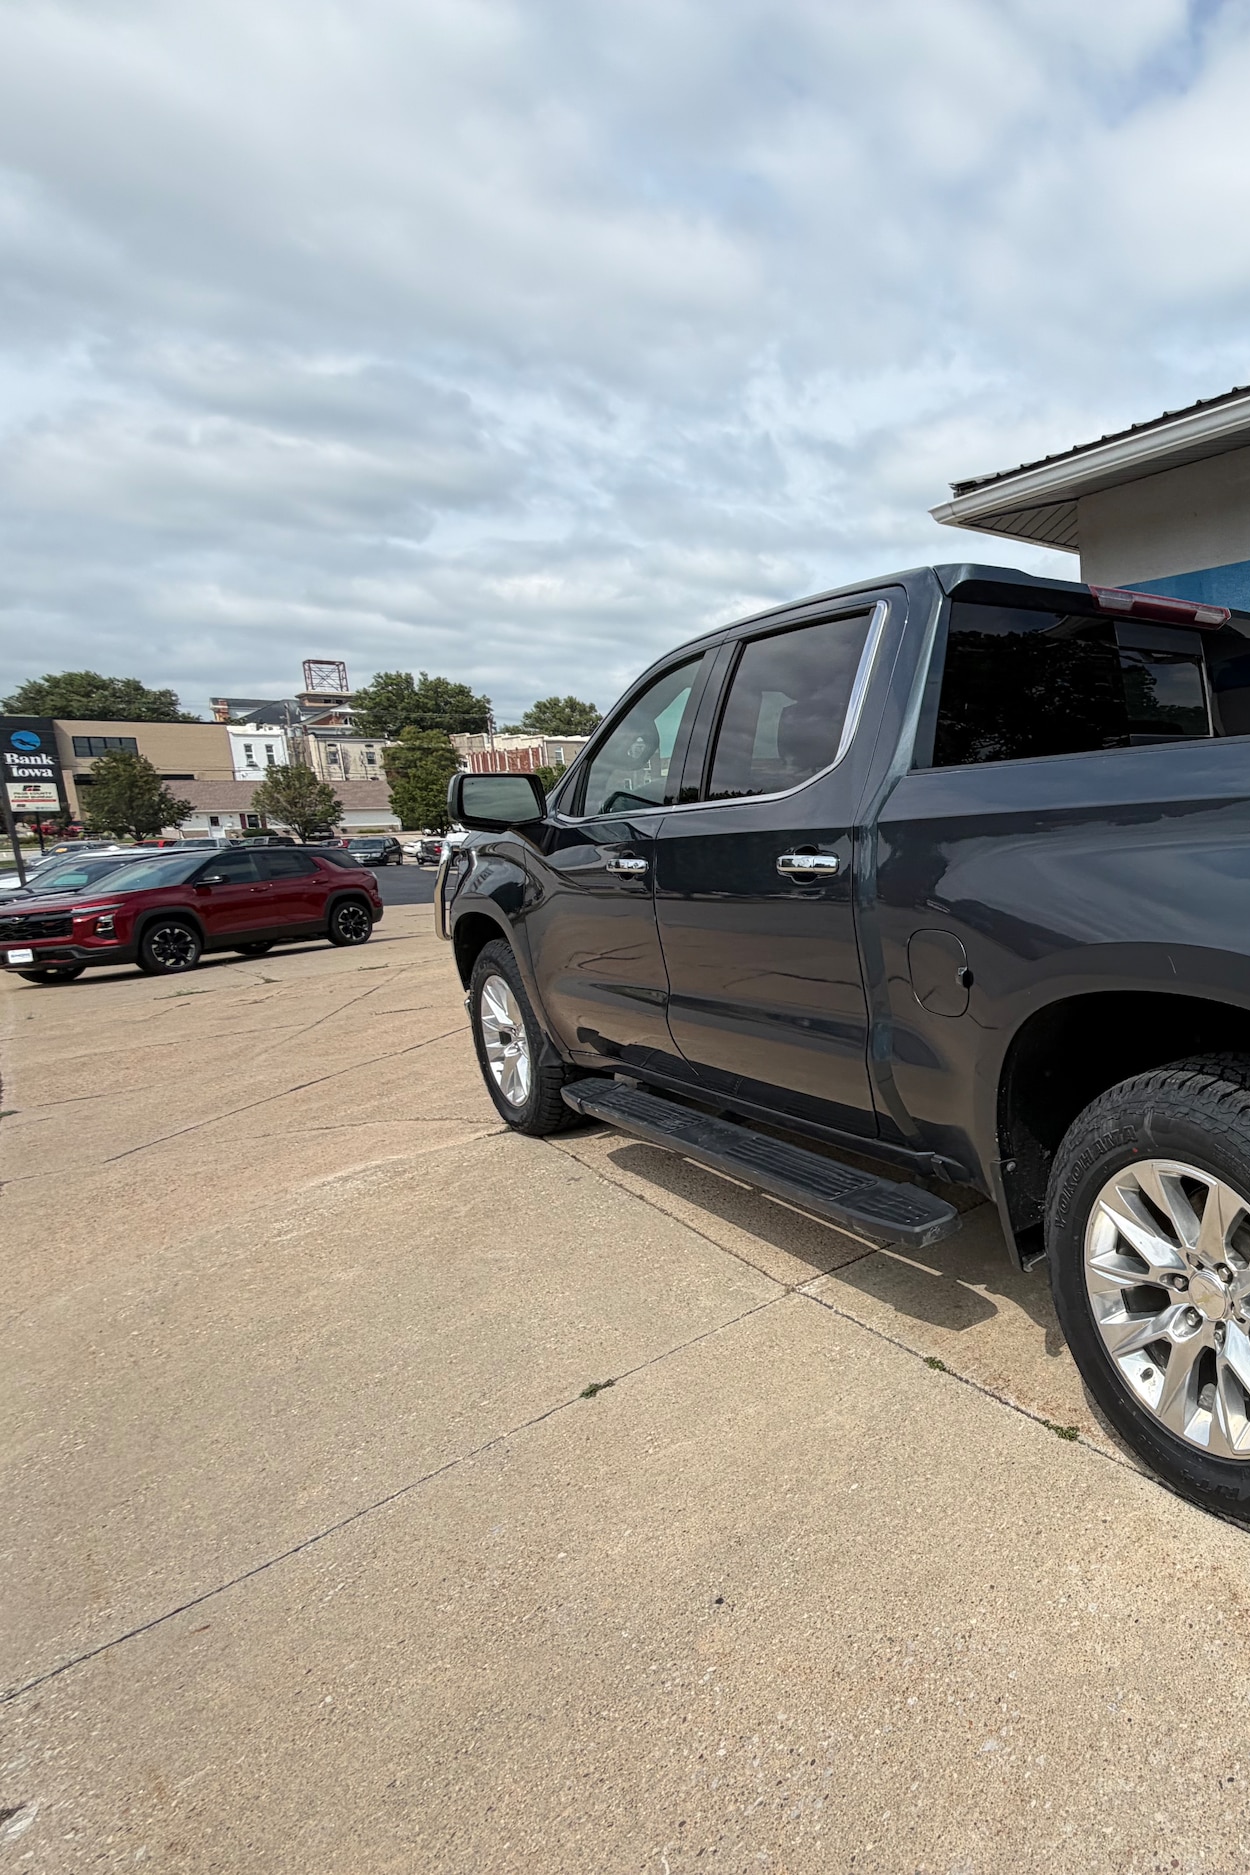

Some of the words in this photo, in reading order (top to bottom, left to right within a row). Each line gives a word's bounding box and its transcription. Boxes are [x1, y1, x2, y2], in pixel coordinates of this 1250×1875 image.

[4, 752, 55, 765] Bank
[10, 765, 53, 777] Iowa
[1055, 1124, 1138, 1228] YOKOHAMA
